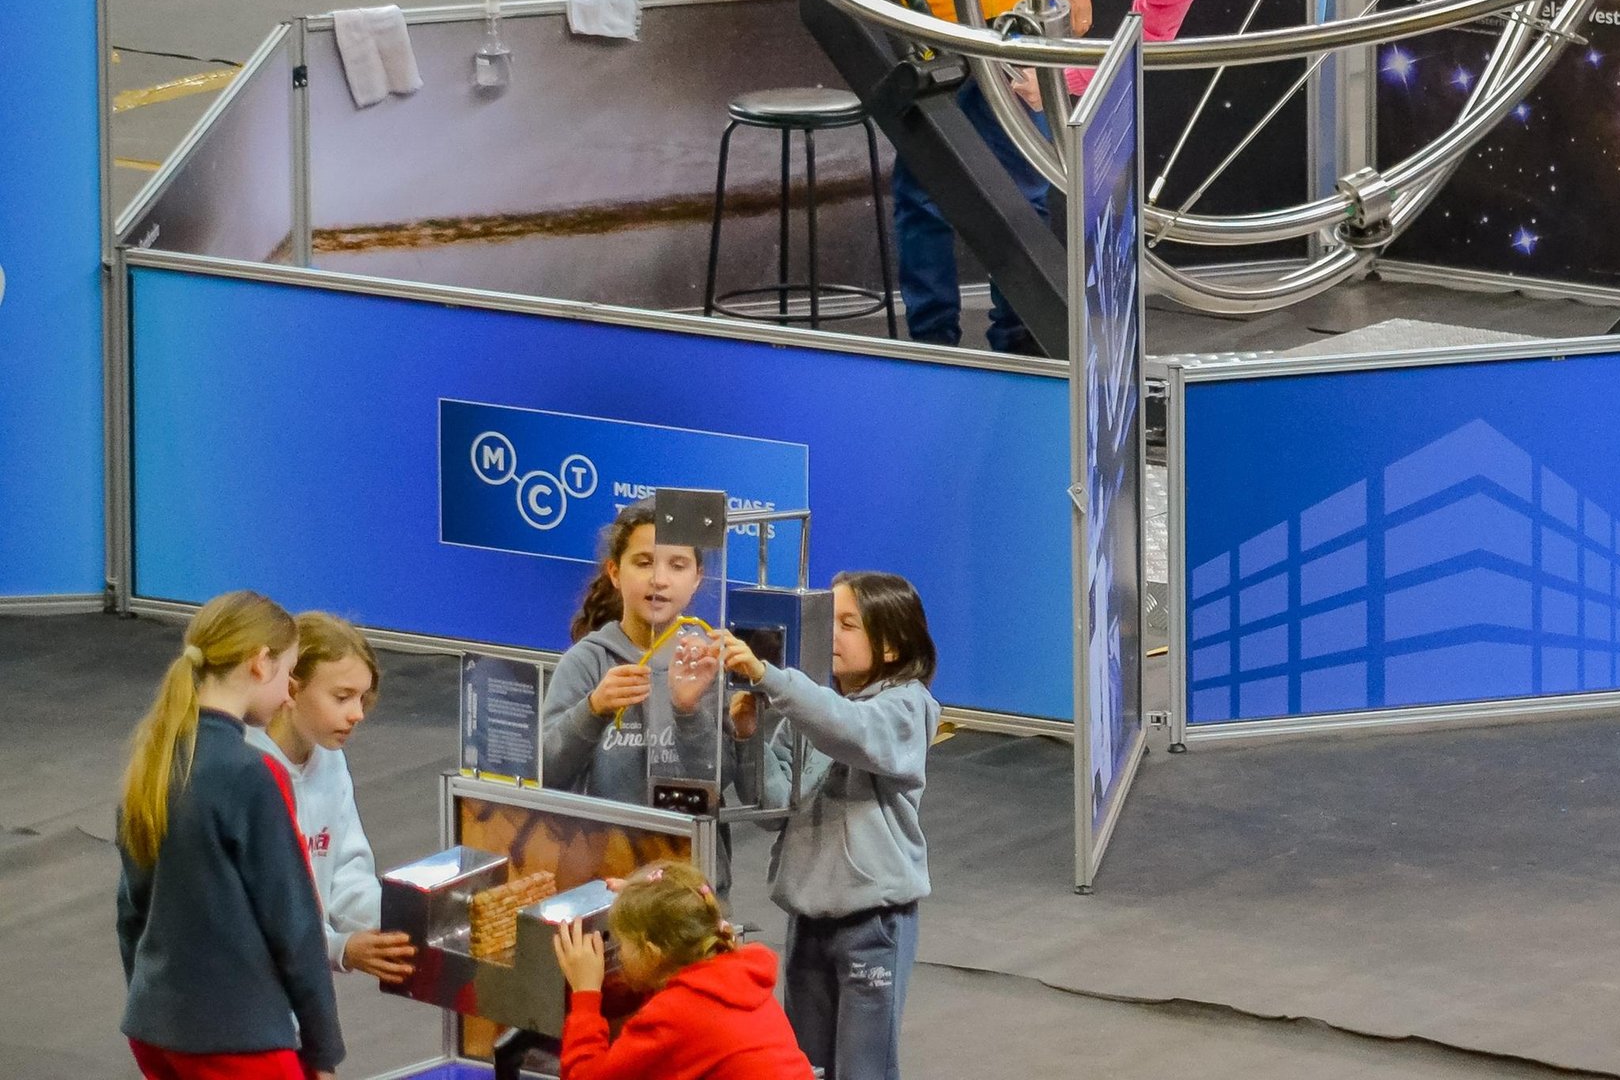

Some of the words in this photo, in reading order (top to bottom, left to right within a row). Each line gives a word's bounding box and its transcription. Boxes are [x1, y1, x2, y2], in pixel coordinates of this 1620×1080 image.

[482, 445, 504, 471] M
[528, 484, 553, 516] C
[571, 467, 587, 489] T
[614, 482, 656, 499] MUSE
